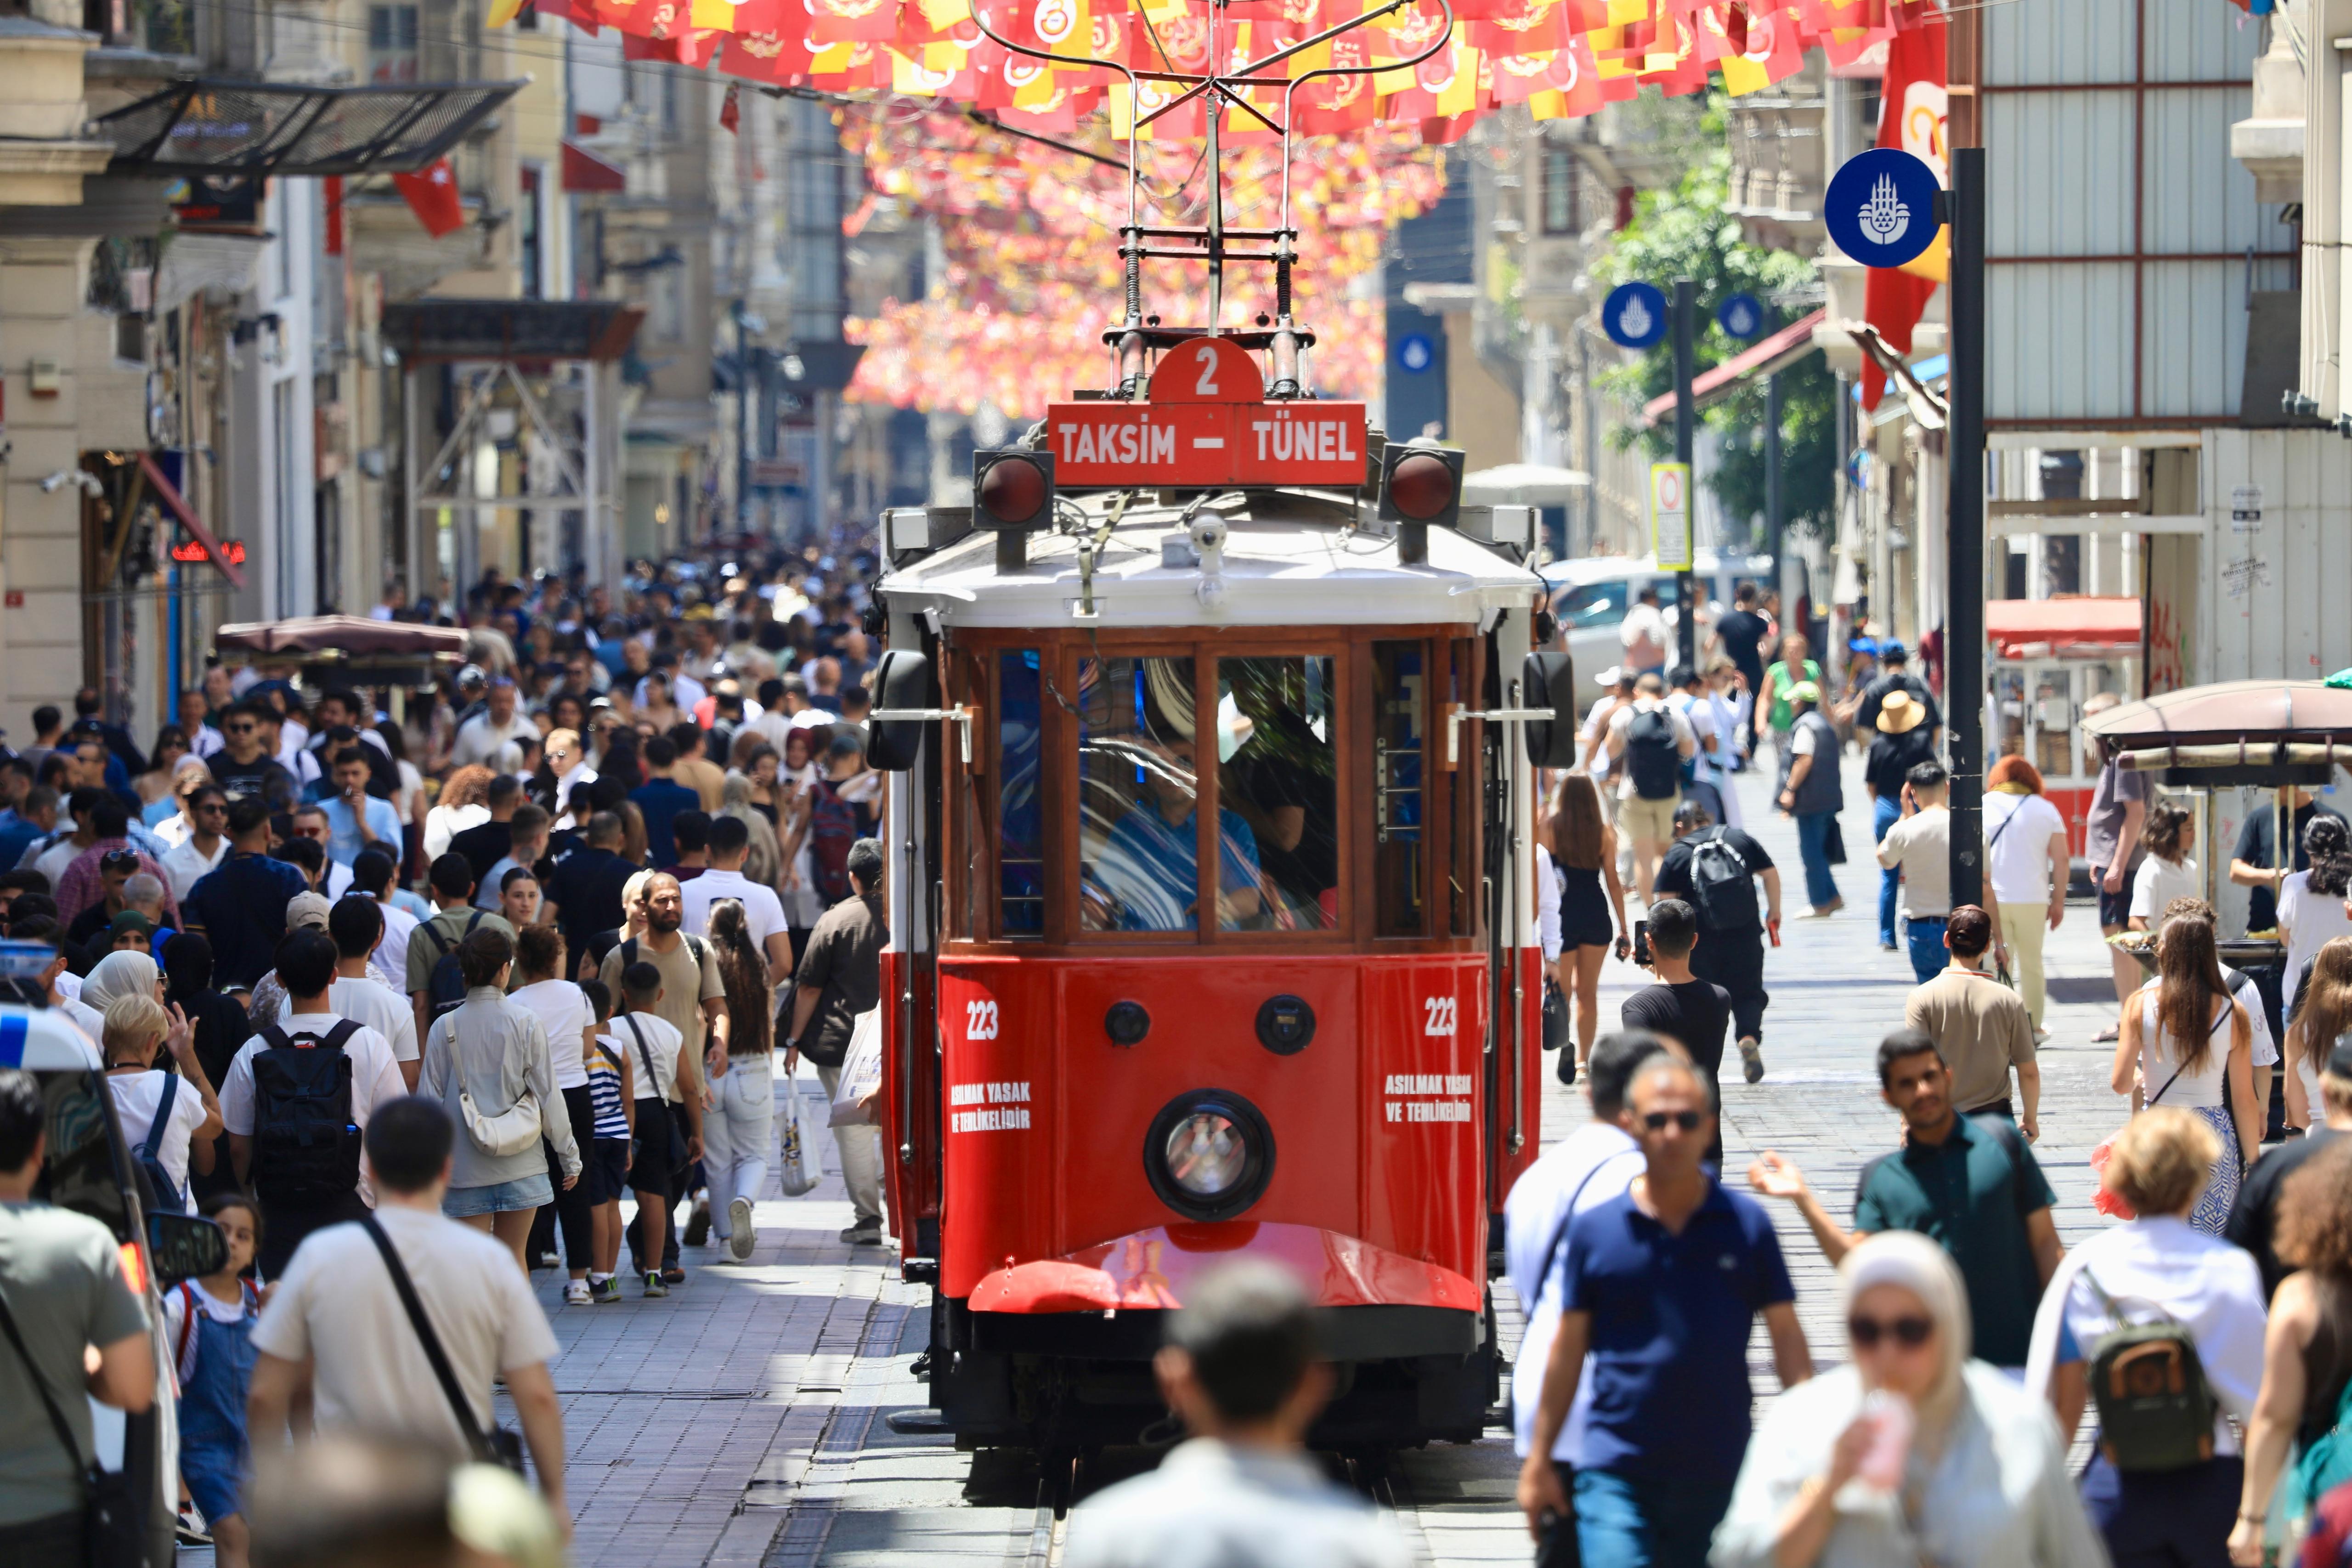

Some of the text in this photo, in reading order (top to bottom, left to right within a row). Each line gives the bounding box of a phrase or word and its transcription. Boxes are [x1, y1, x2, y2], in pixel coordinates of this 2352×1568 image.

[1196, 346, 1218, 395] 2
[1058, 413, 1175, 464] TAKSİM
[1253, 411, 1356, 461] TÜNEL
[967, 1000, 998, 1040] 223
[1425, 997, 1457, 1036] 223
[951, 1082, 1031, 1106] ASILMAK YASAK
[1385, 1075, 1443, 1094] ASILMAK
[951, 1106, 1030, 1133] VE TEHLİKELİDİR
[1385, 1102, 1402, 1122] VE
